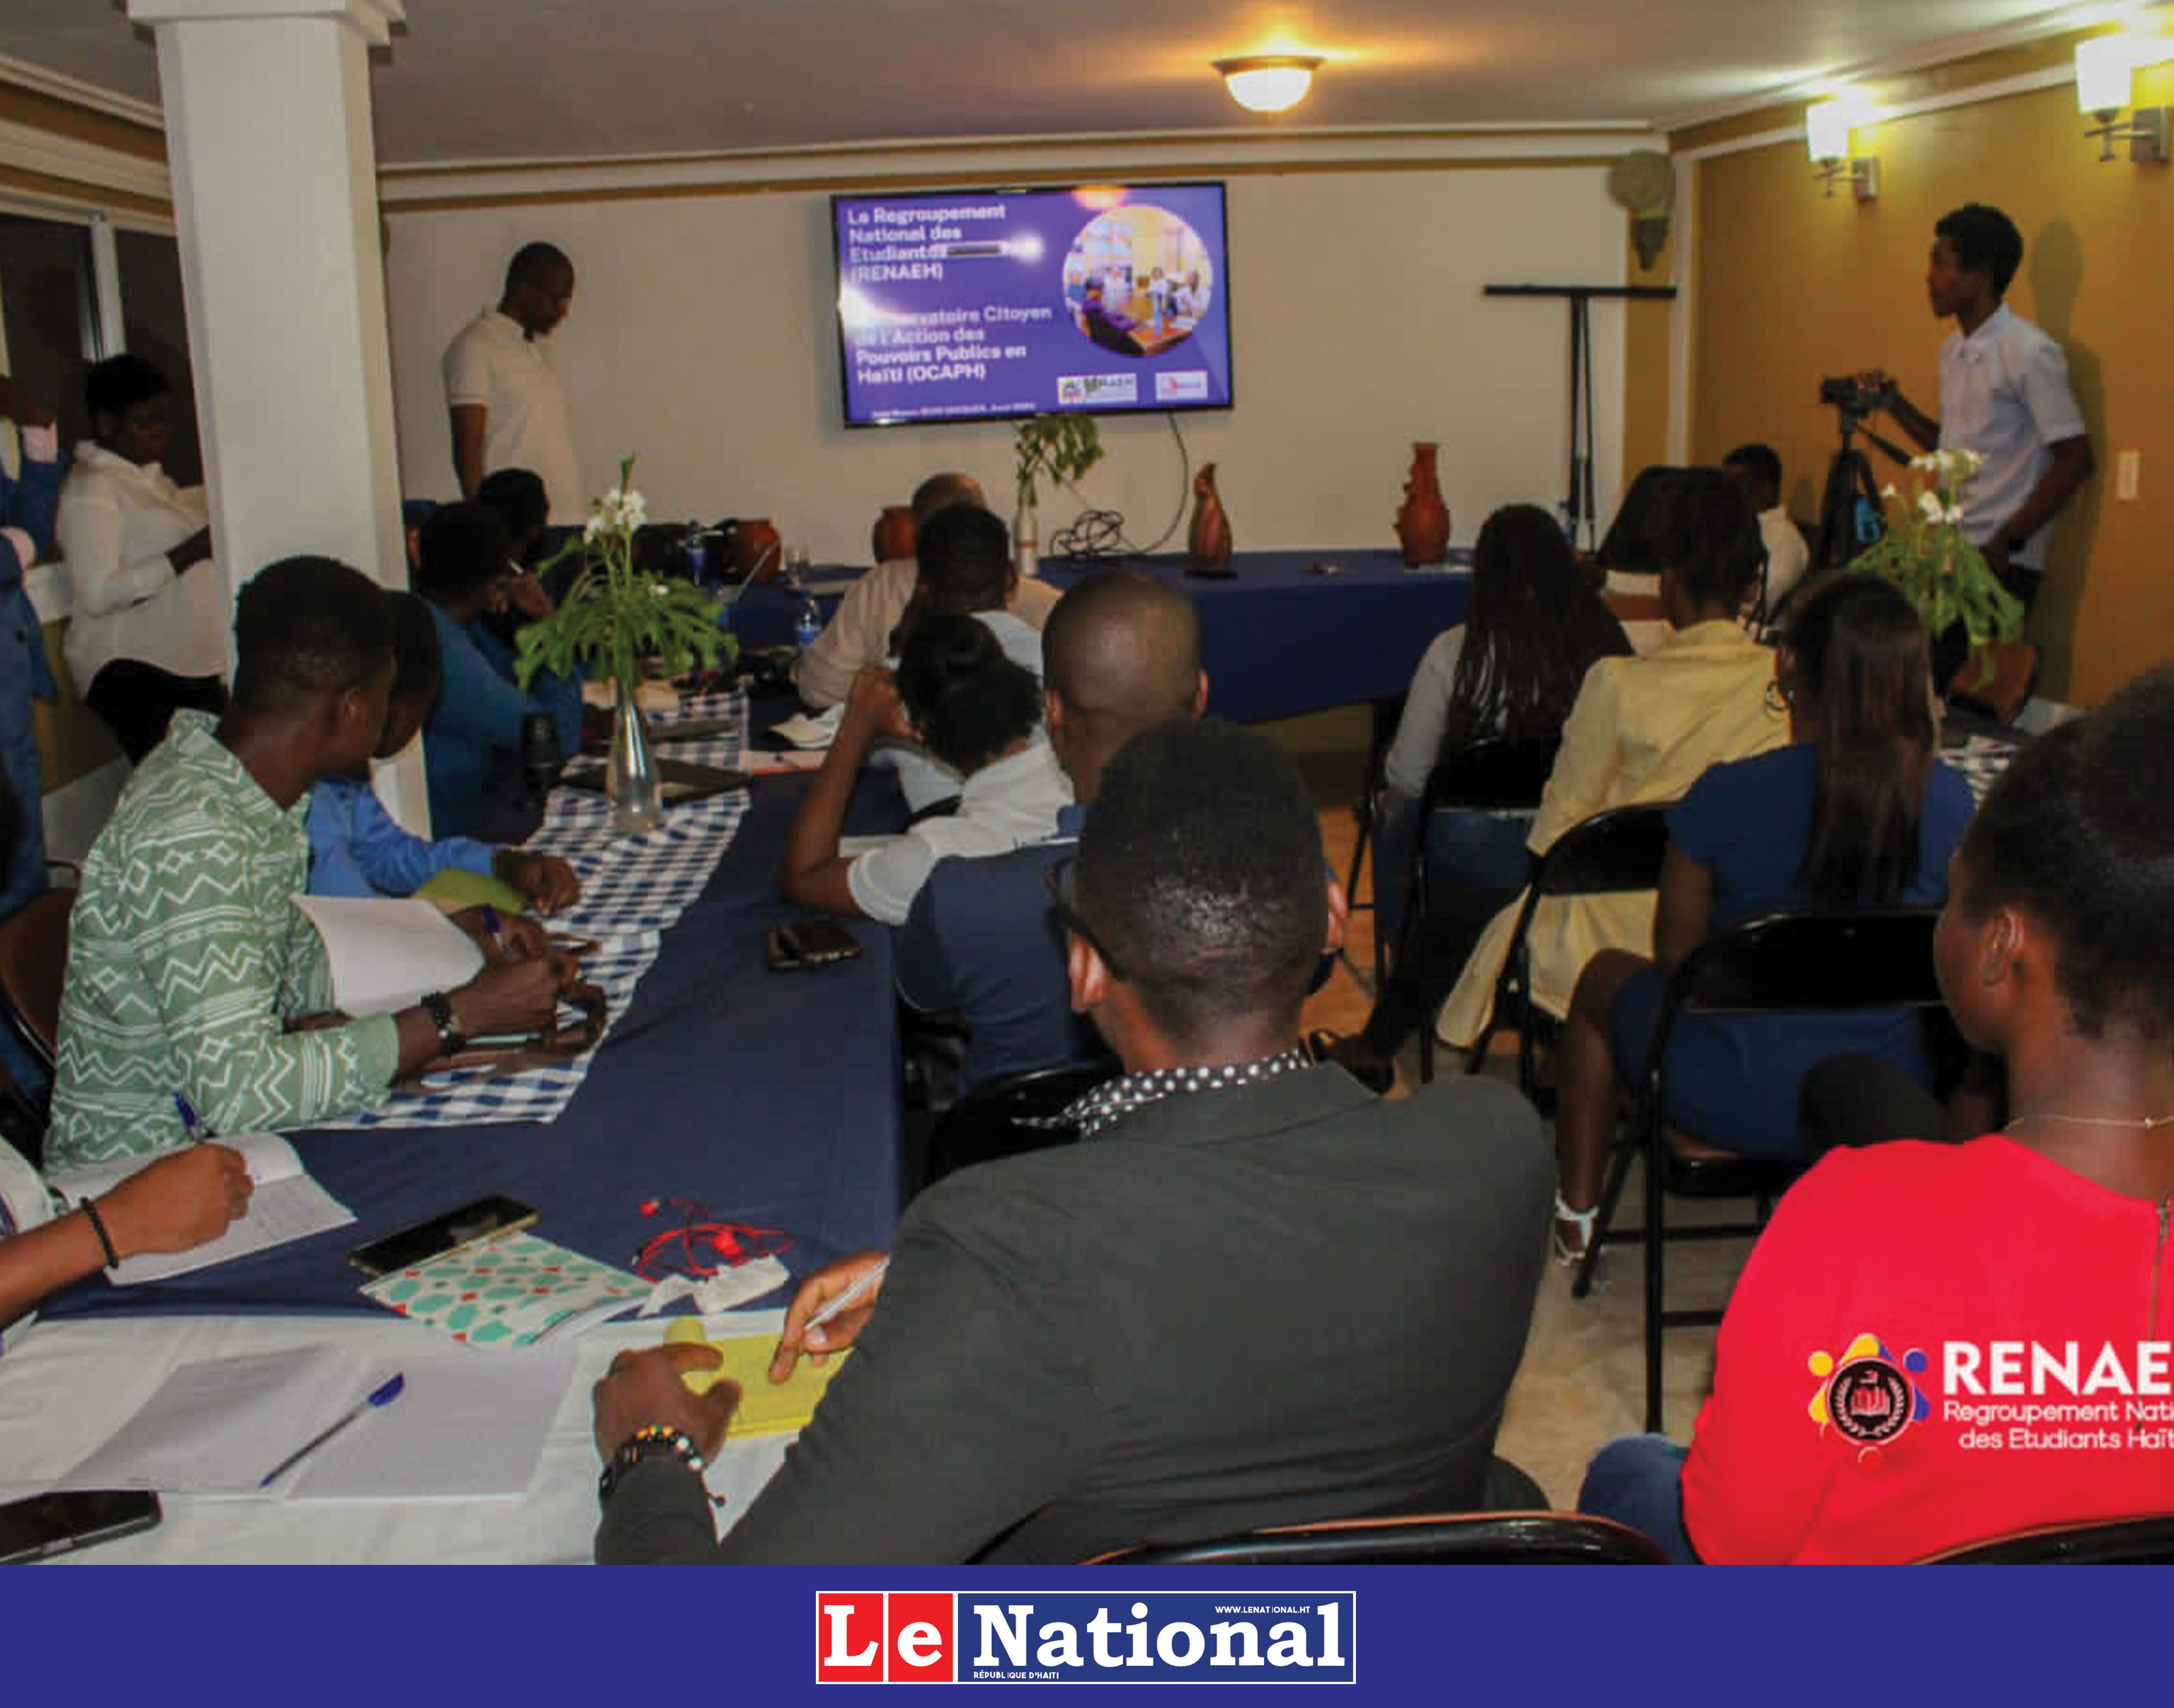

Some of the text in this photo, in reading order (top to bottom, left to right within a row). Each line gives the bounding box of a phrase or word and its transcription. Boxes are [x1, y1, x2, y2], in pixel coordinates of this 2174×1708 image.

[848, 204, 1006, 225] Le Regroupement
[850, 225, 962, 244] National des
[851, 262, 943, 282] (RENAEH)
[984, 305, 1052, 322] Citoyen
[953, 326, 985, 342] des
[856, 344, 1026, 365] Pouvoirs Publics en
[907, 363, 986, 385] (OCAPH)
